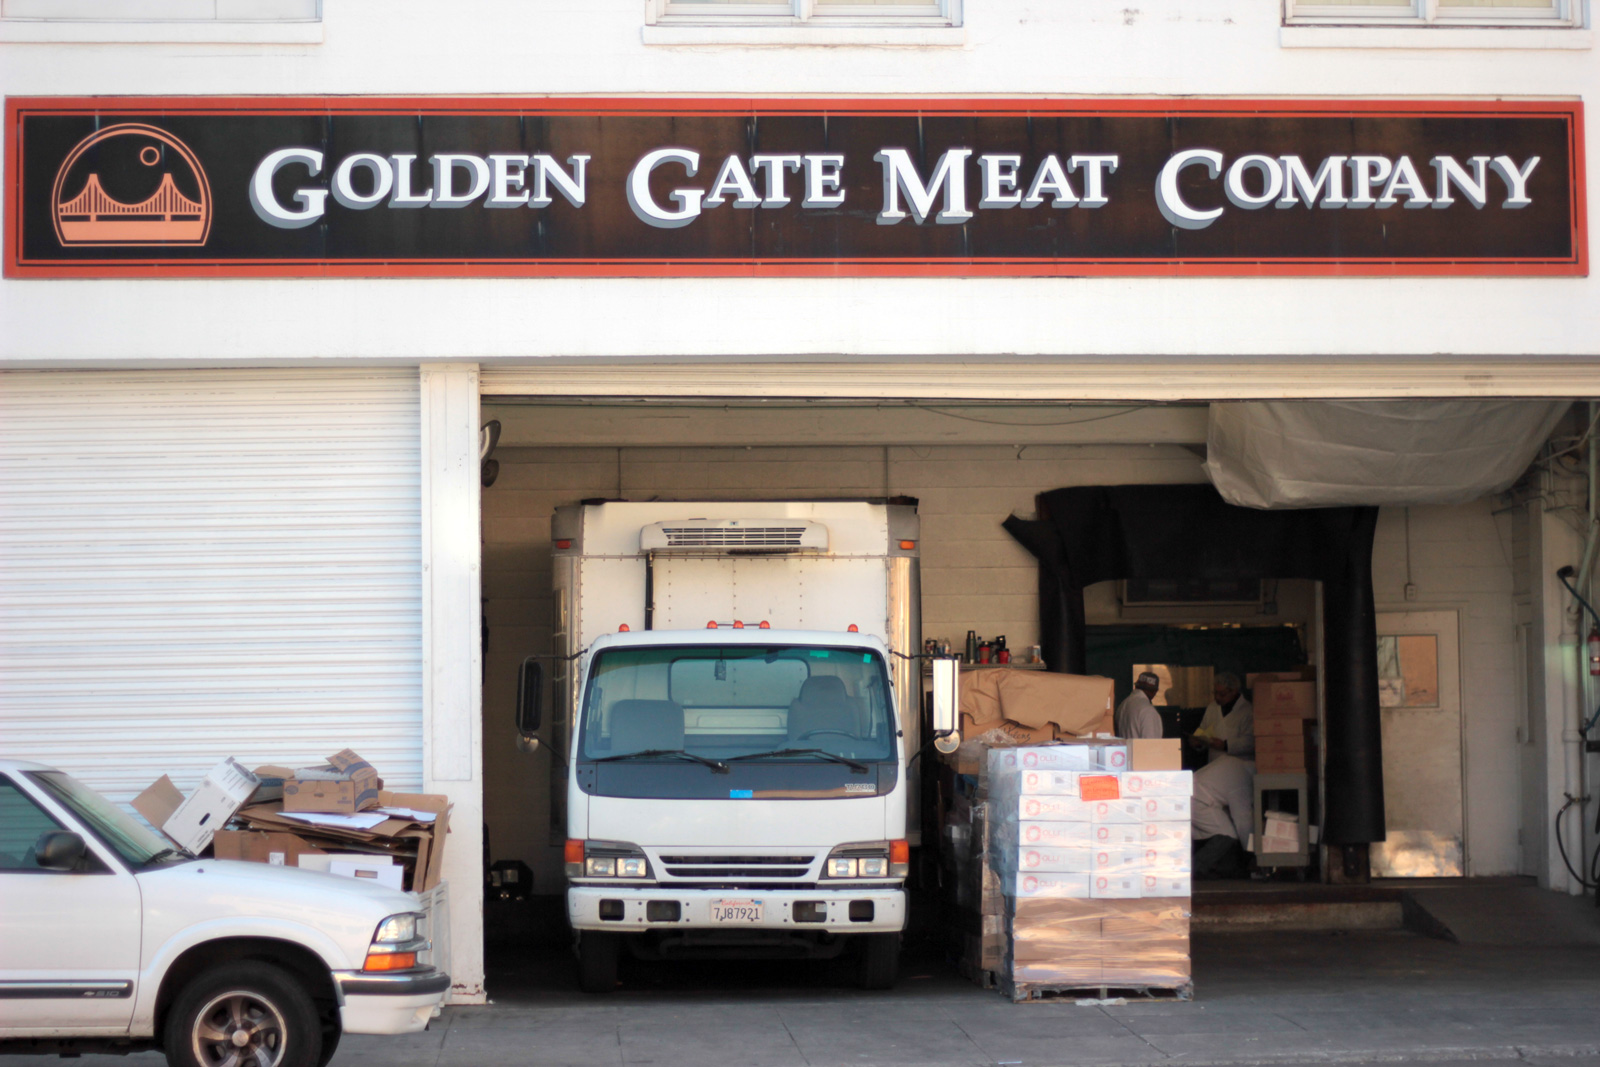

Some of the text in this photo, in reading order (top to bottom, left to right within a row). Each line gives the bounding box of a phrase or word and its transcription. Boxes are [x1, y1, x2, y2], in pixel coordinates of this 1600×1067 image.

[249, 147, 1541, 230] GOLDEN GATE MEAT COMPANY
[713, 907, 760, 920] 7J87921
